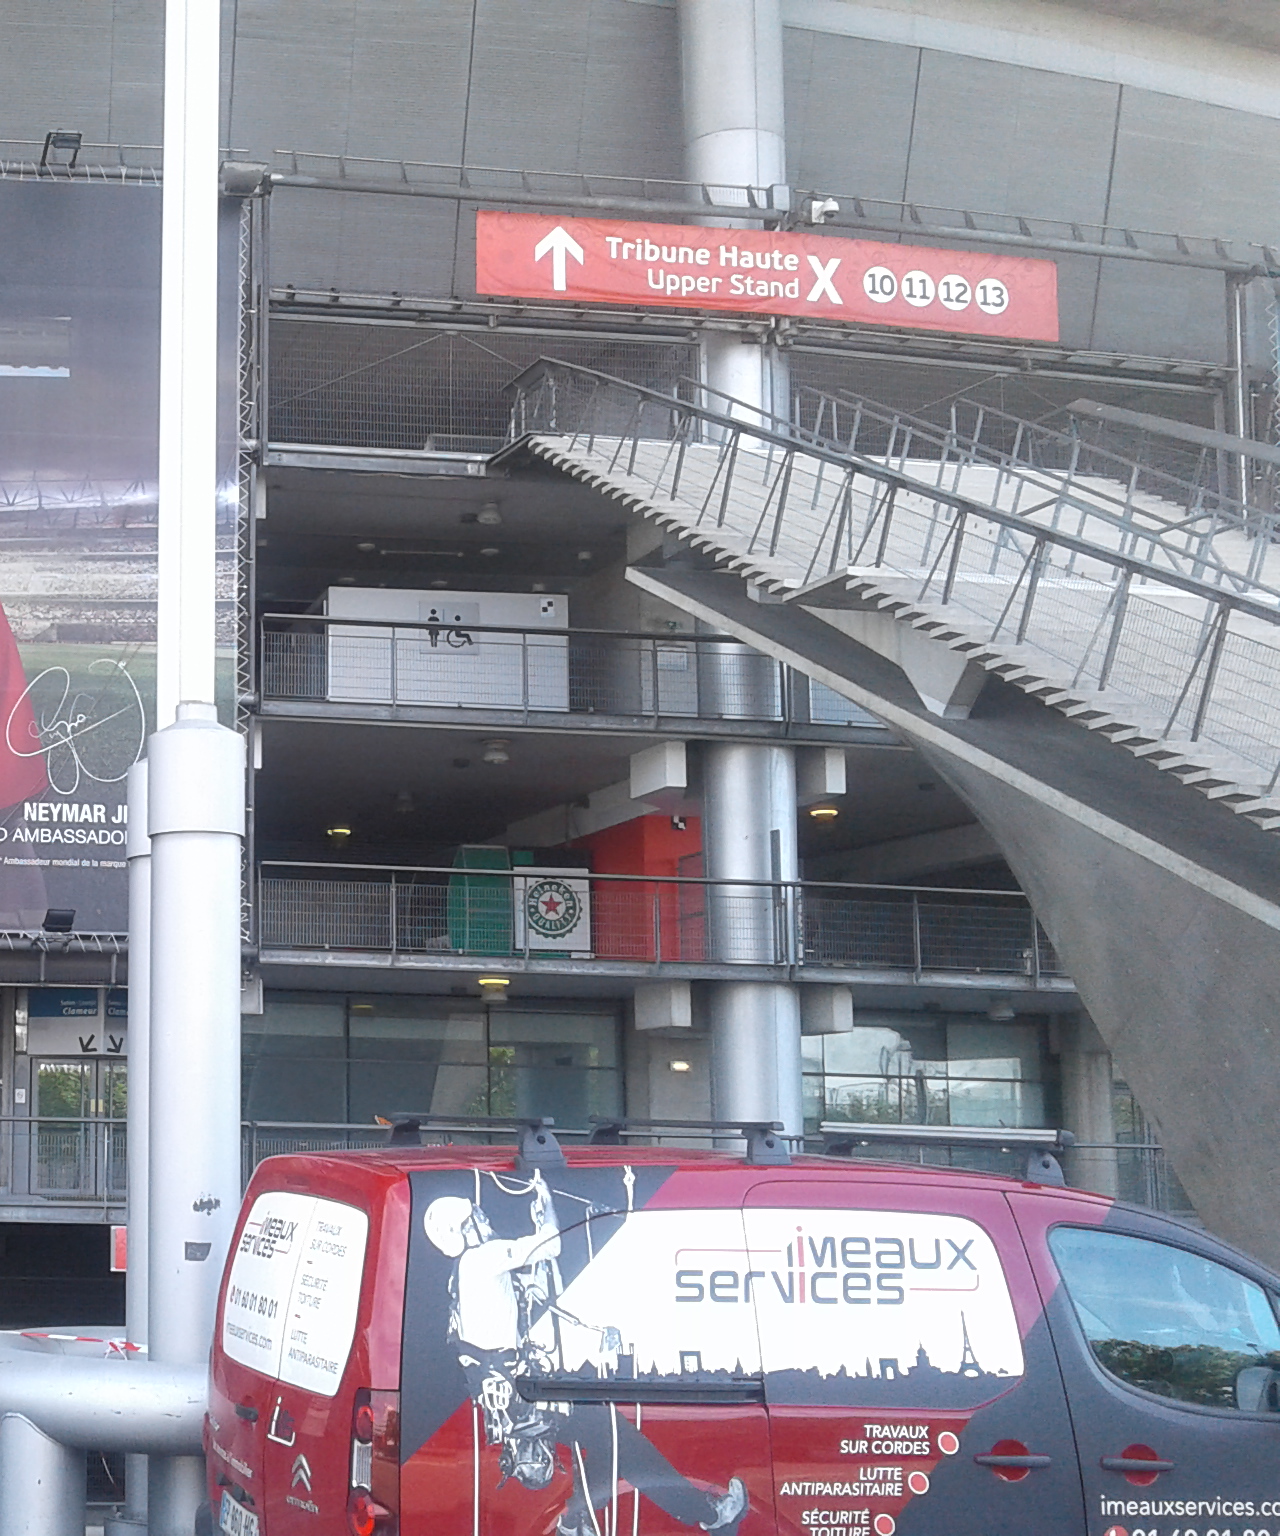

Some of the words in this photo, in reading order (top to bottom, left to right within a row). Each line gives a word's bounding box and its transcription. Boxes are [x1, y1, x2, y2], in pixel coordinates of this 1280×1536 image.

[605, 236, 710, 265] Tribune
[719, 245, 799, 271] Haute
[647, 268, 722, 297] Upper
[729, 273, 799, 298] Stand
[806, 254, 844, 305] X
[868, 272, 895, 297] 10
[904, 277, 931, 300] 11
[942, 281, 968, 304] 12
[979, 284, 1005, 308] 13
[24, 802, 107, 824] NEYMAR
[12, 828, 128, 846] AMBASSADO
[3, 856, 51, 867] Ambassadeur
[52, 858, 80, 867] mondial
[81, 859, 91, 867] de
[92, 859, 99, 867] la
[100, 861, 126, 869] marque
[529, 884, 574, 907] Heineken
[532, 913, 572, 930] QUALITY
[62, 1007, 98, 1015] Clameur
[675, 1269, 905, 1305] services
[864, 1424, 929, 1439] TRAVAUX
[840, 1439, 869, 1454] SUR
[871, 1440, 931, 1455] CORDES
[859, 1467, 903, 1481] LUTTE
[780, 1482, 903, 1496] ANTIPARASITAIRE
[801, 1507, 870, 1525] SÉCURITÉ
[810, 1526, 871, 1536] TOITURE
